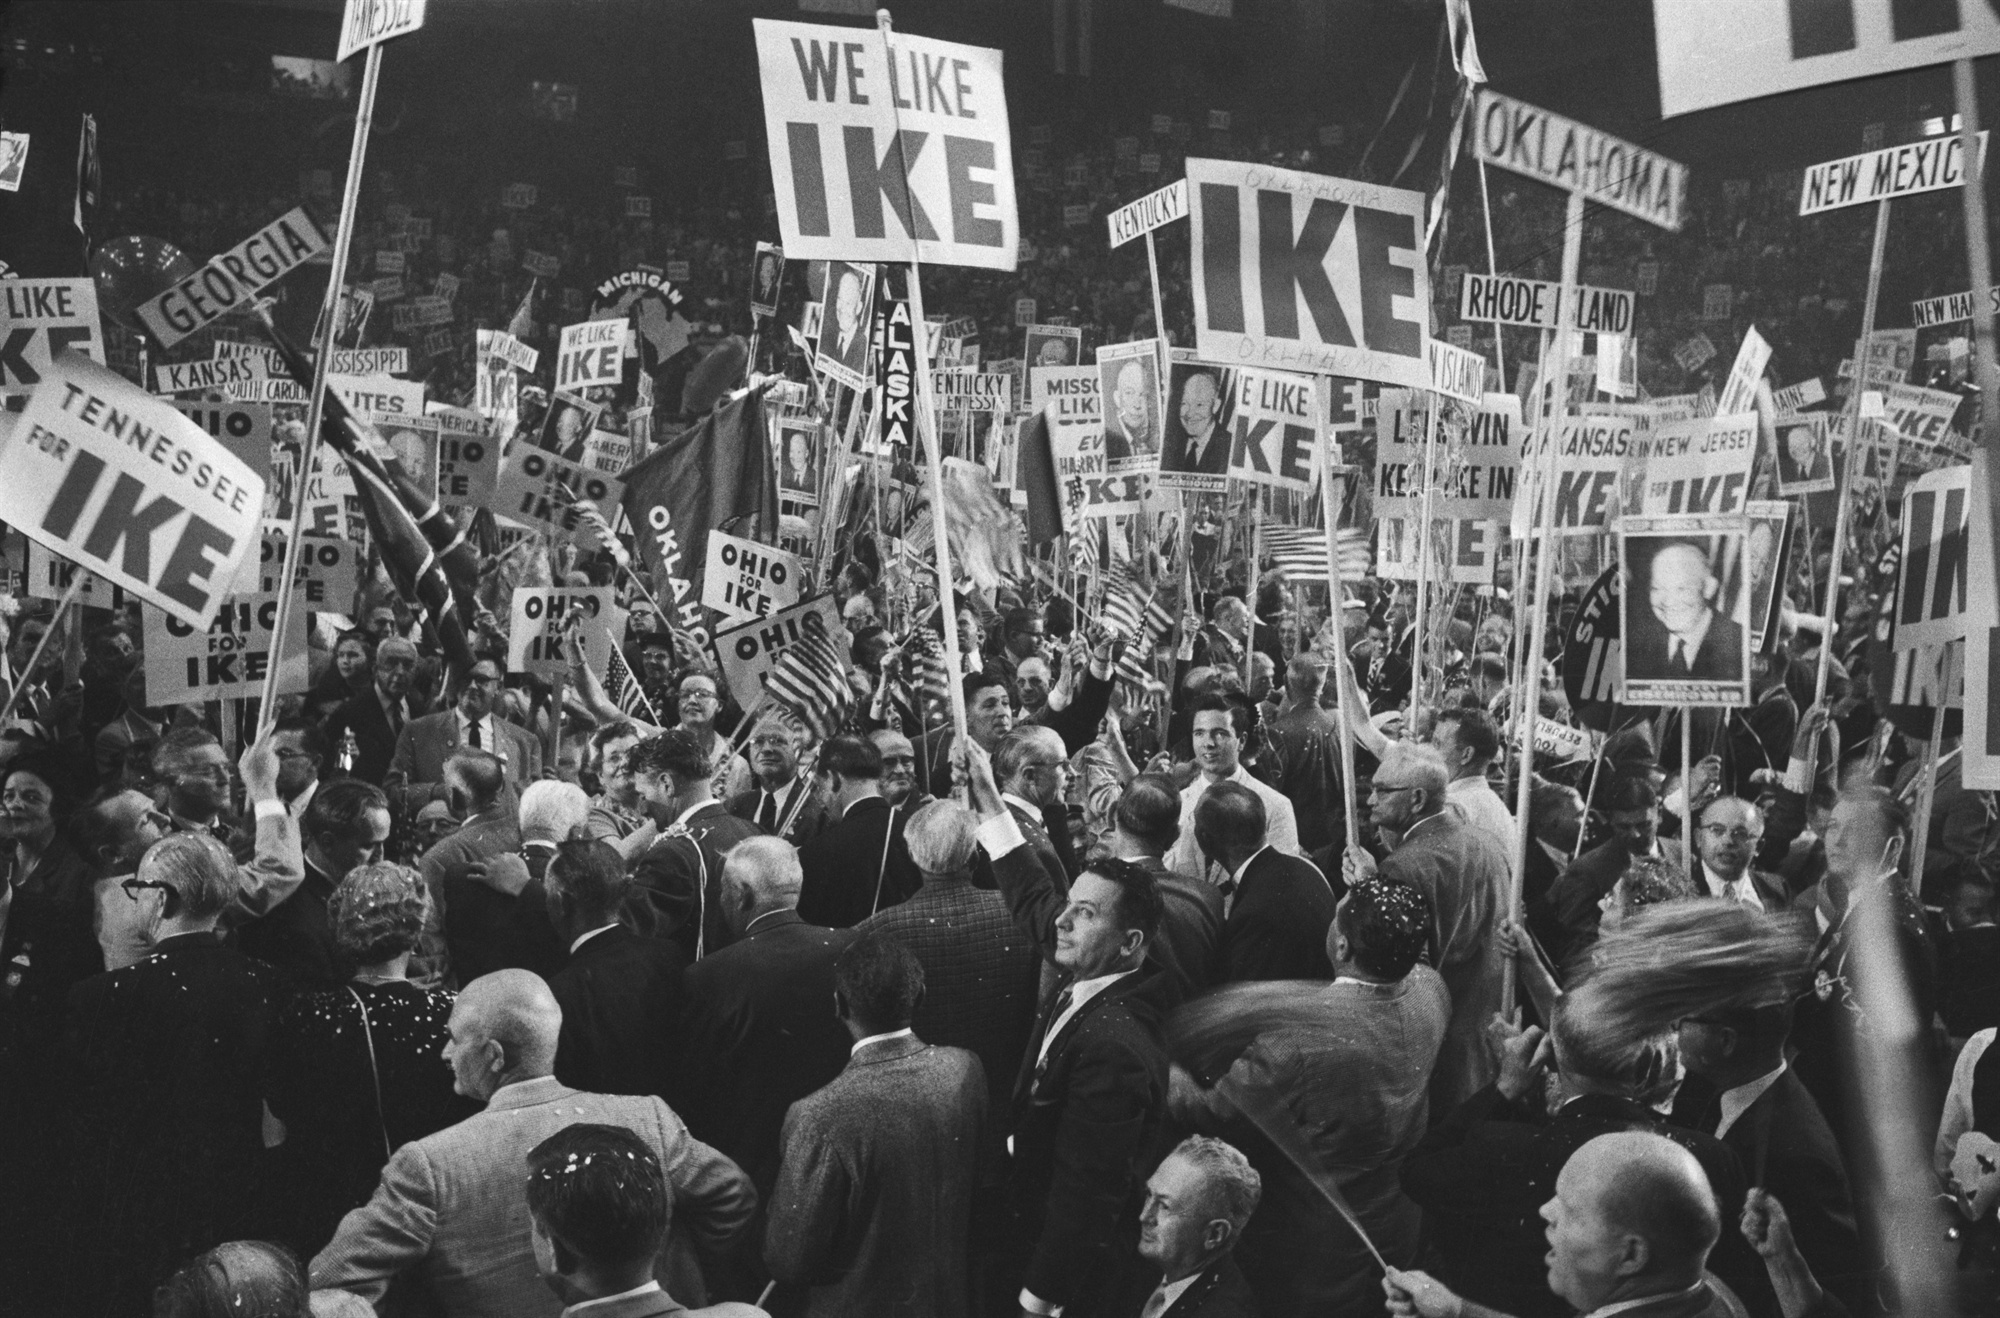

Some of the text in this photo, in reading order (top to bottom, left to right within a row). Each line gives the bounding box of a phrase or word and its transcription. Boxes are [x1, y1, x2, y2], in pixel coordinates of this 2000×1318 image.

[790, 37, 977, 119] WE LIKE
[1484, 101, 1673, 216] OKLAHOMA
[1806, 136, 1981, 210] NEW MEXIC
[786, 120, 1004, 248] IKE
[1114, 184, 1178, 243] KENTUCKY
[158, 219, 313, 333] GEORGIA
[597, 271, 683, 305] MICHIGAN
[1200, 181, 1422, 359] IKE
[5, 286, 76, 319] LIKE
[1468, 277, 1629, 332] RHODE ILAND
[1914, 299, 1944, 326] NEW
[569, 324, 618, 347] WE LIKE
[169, 358, 253, 390] KANSAS
[329, 351, 403, 374] ISSISSIPPI
[560, 345, 619, 386] IKE
[885, 302, 911, 446] ALASKA
[1442, 346, 1484, 401] ISLANDS
[930, 373, 1004, 396] ENTUCKY
[1260, 379, 1309, 417] LIKE
[1060, 397, 1100, 414] LIK
[25, 424, 71, 462] FOR
[61, 380, 249, 514] TENNESSEE
[1231, 415, 1316, 483] KE
[1653, 428, 1753, 457] NEW JERSEY
[1487, 466, 1514, 499] IN
[1651, 482, 1669, 498] FOR
[1667, 471, 1747, 514] IKE
[40, 447, 237, 612] IKE
[721, 543, 787, 586] OHIO
[739, 573, 762, 592] FOR
[724, 580, 772, 617] IKE
[208, 636, 247, 652] FOR
[532, 634, 586, 661] IK
[735, 609, 824, 661] OHIO
[187, 650, 269, 688] IKE
